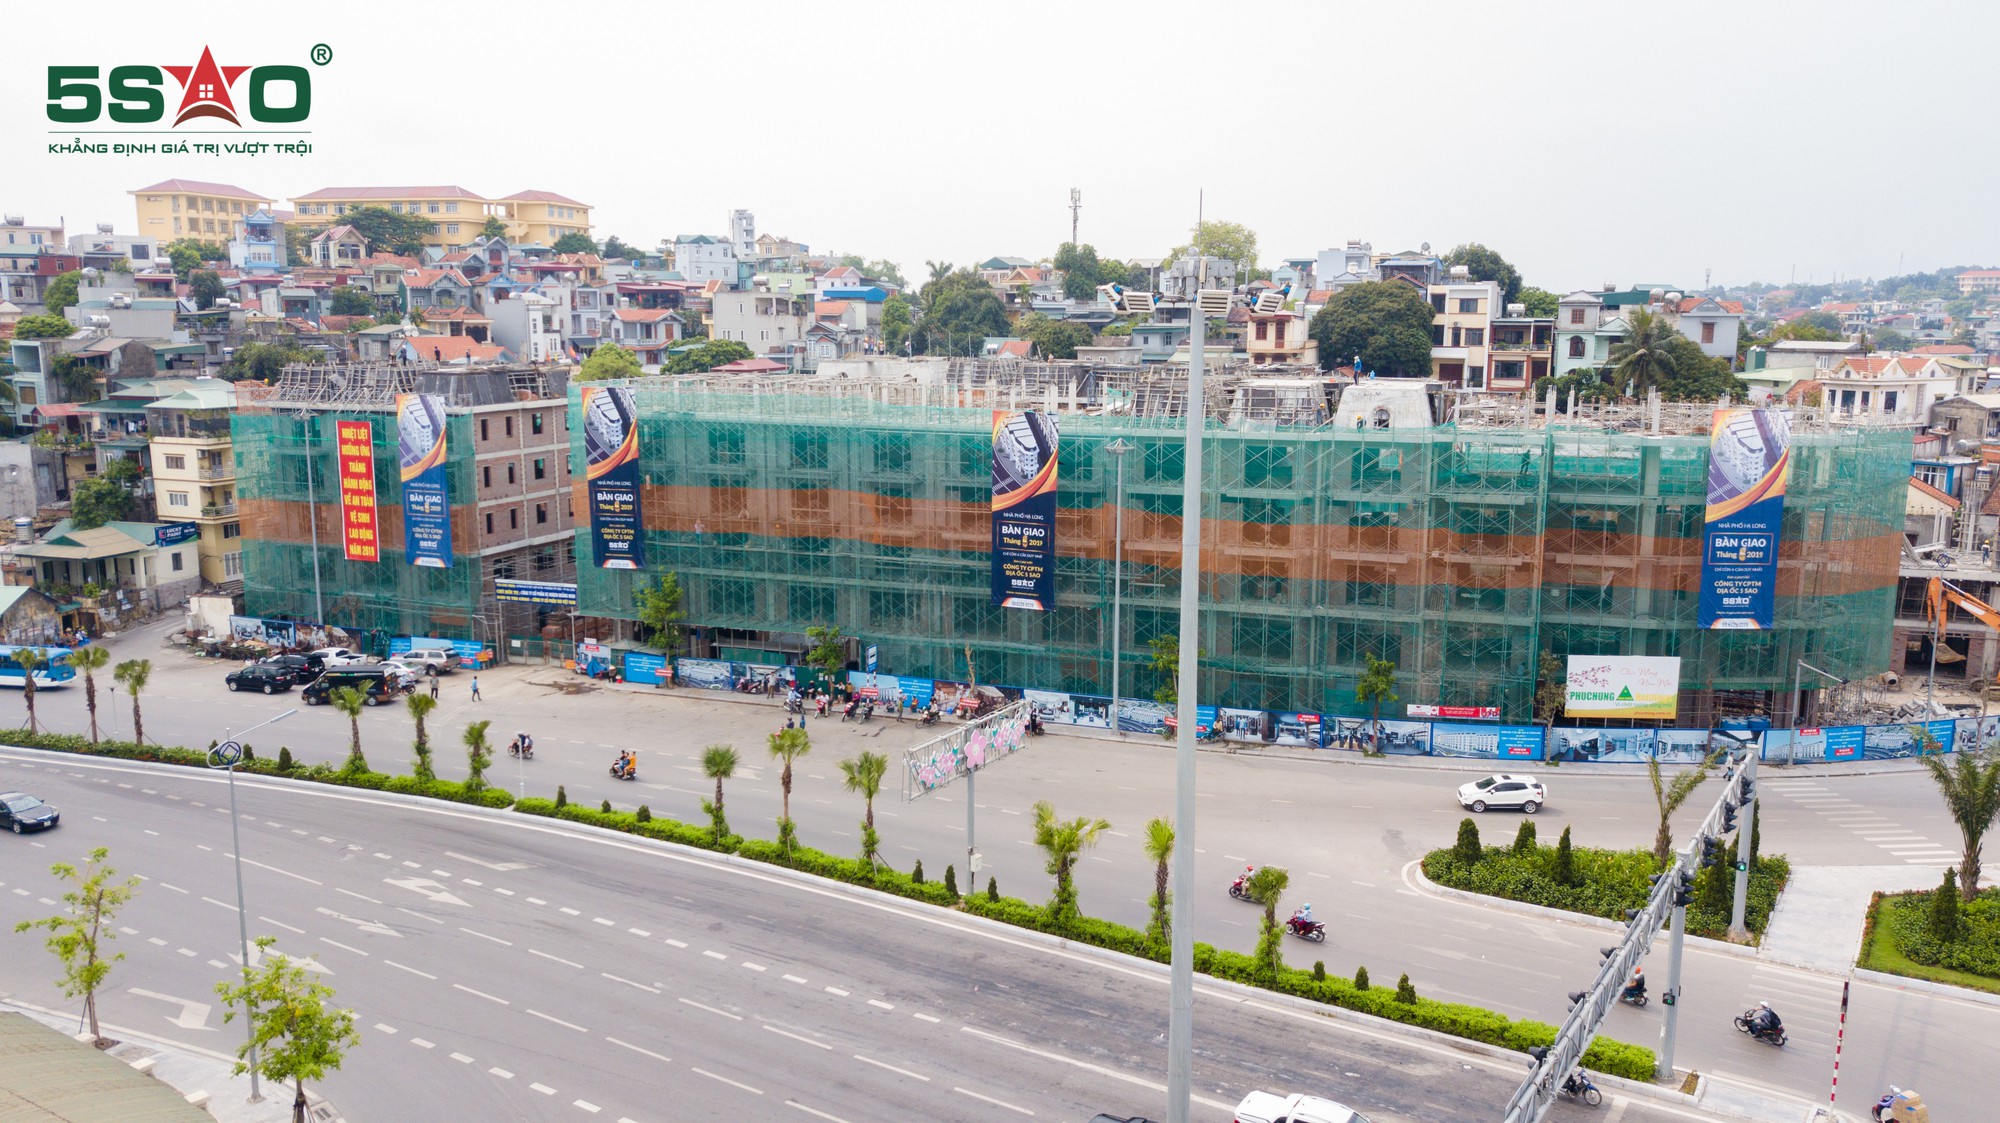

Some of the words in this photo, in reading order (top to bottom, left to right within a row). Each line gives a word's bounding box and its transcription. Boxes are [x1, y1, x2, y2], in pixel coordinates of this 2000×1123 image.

[410, 493, 423, 502] BÀN
[425, 495, 441, 503] GIAO
[597, 492, 613, 501] BÀN
[1002, 524, 1020, 534] BÀN
[1023, 528, 1045, 536] GIAO
[1003, 537, 1021, 546] Tháng
[1715, 536, 1738, 547] BÀN
[1741, 539, 1766, 547] GIAO
[1716, 551, 1737, 559] Tháng
[1570, 692, 1614, 700] PHUCHUNG
